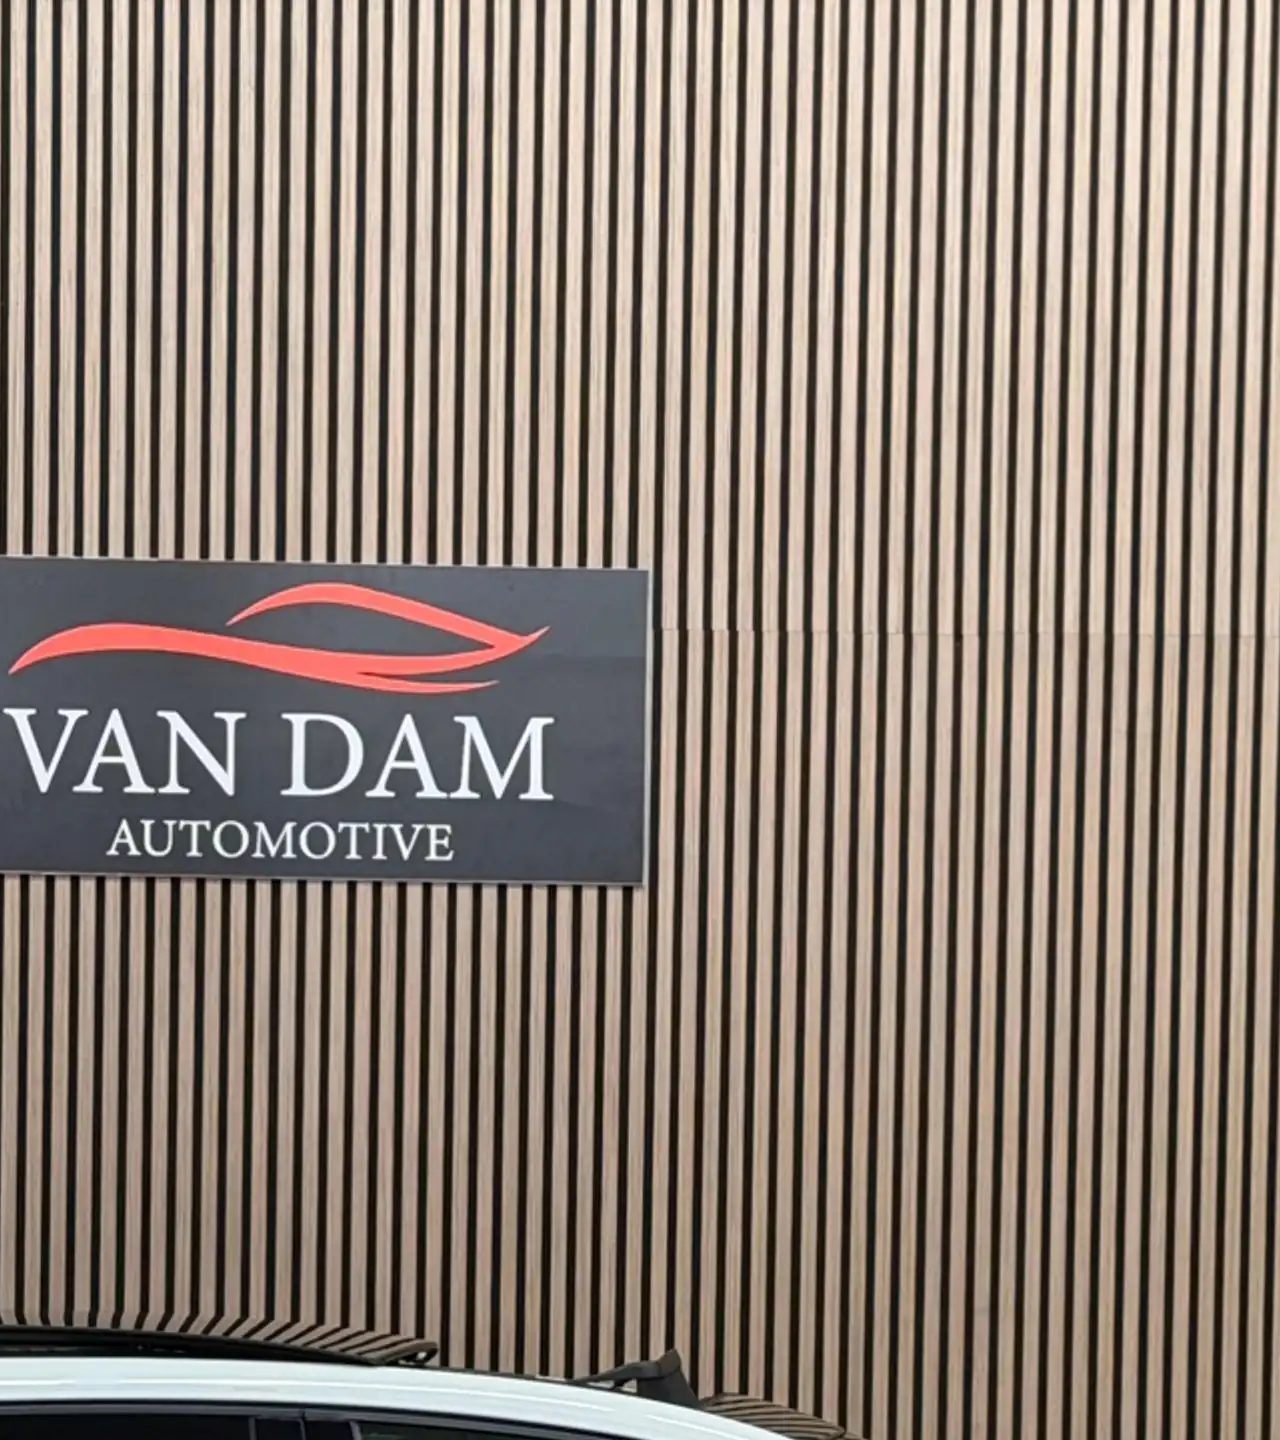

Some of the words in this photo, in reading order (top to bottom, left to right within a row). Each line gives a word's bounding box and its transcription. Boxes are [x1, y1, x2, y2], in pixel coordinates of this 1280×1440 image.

[2, 707, 247, 796] VAN
[280, 712, 556, 801] DAM
[105, 818, 455, 862] AUTOMOTIVE
